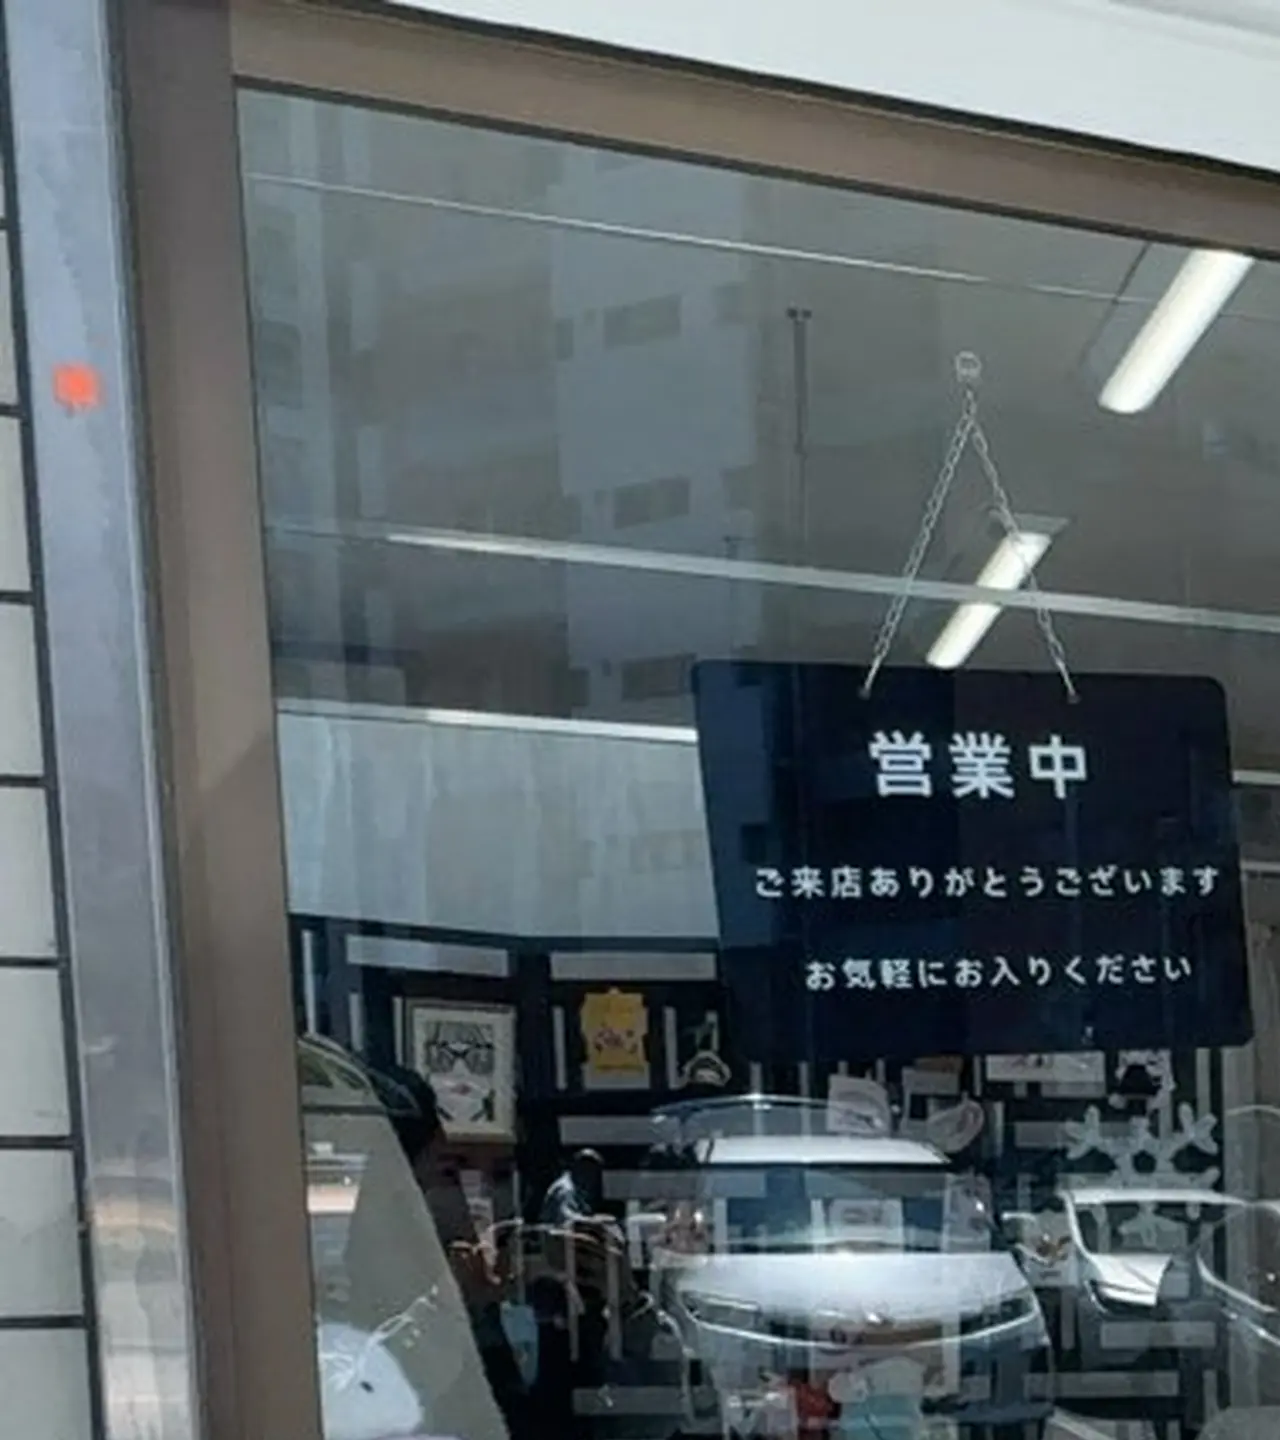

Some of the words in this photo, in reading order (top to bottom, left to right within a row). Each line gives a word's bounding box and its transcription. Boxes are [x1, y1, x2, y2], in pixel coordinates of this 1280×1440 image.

[868, 730, 1088, 800] 営業中
[754, 864, 1221, 900] ご来店ありがとうございます
[805, 955, 1193, 993] お気軽にお入りください
